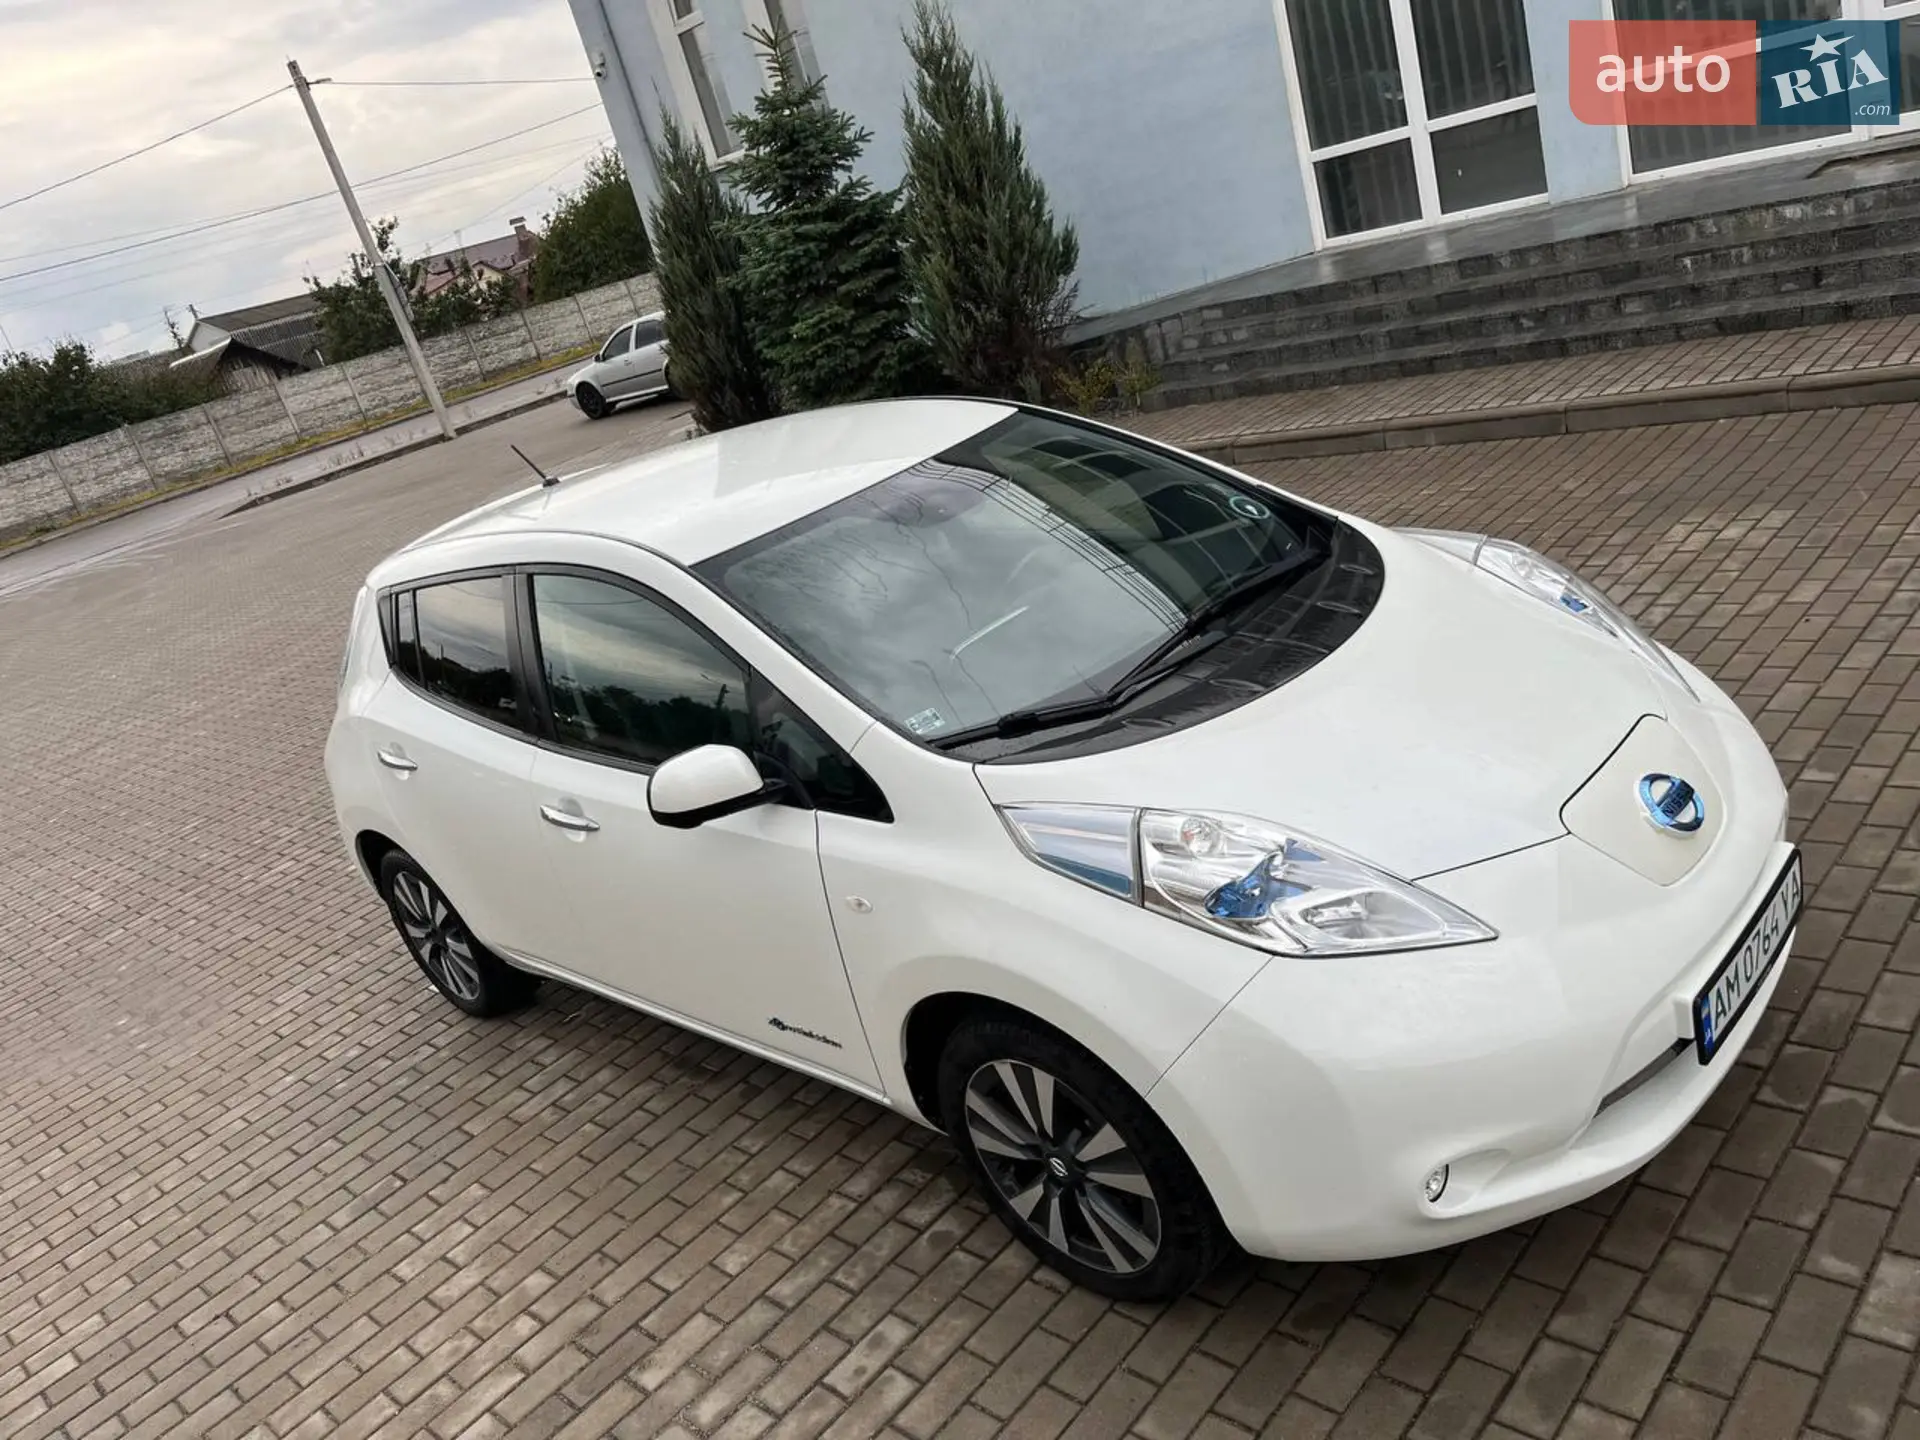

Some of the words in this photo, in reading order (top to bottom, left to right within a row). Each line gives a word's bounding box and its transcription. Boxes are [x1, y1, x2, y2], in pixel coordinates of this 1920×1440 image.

[1714, 962, 1740, 1029] AM
[1743, 903, 1779, 984] 0764
[1781, 872, 1799, 919] YA
